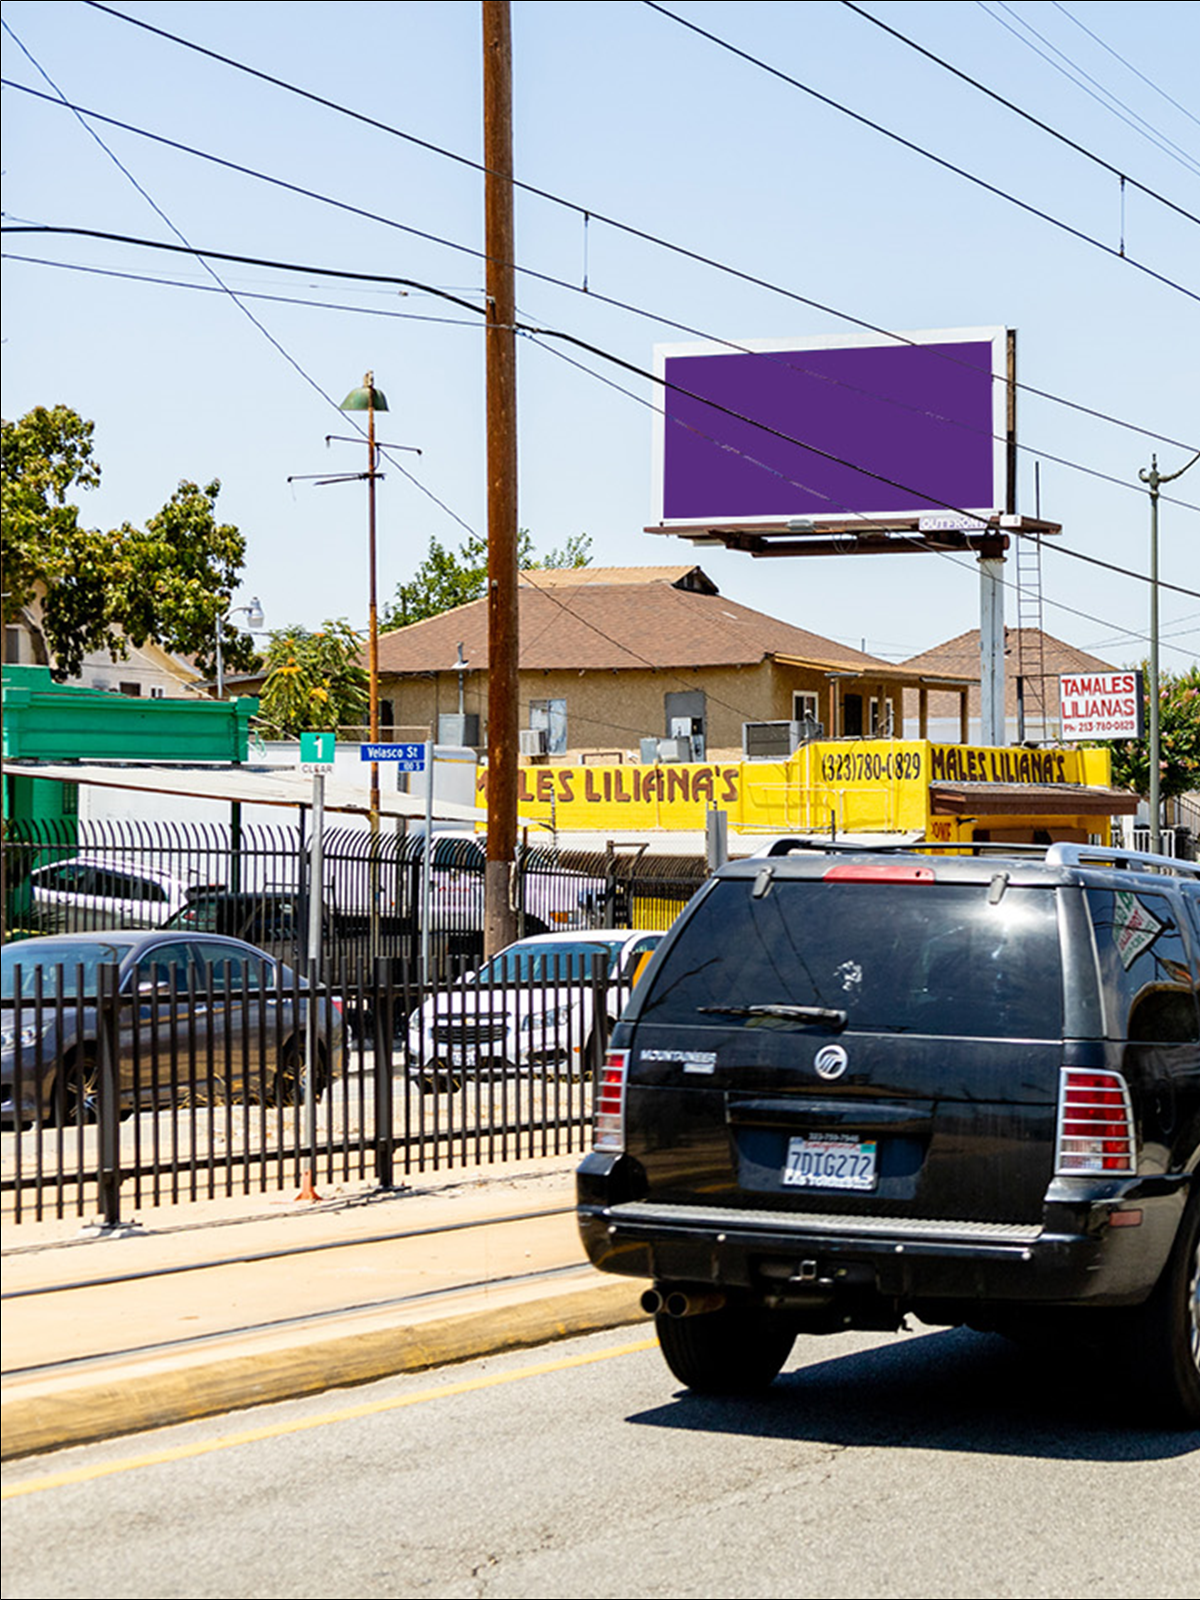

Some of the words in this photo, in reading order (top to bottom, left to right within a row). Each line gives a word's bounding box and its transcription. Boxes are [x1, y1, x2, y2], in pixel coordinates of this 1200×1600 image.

[1061, 675, 1135, 697] TAMALES
[1061, 698, 1135, 720] LILIANAS
[313, 738, 323, 759] 1
[366, 746, 403, 759] Velasco
[406, 746, 418, 758] St
[301, 764, 333, 774] CLEAR
[822, 752, 921, 782] (323)780-0829
[930, 748, 988, 782] MALES
[990, 749, 1066, 784] LILIANA'S
[584, 765, 740, 804] LILIANA'S
[790, 1151, 872, 1180] 7DIG272
